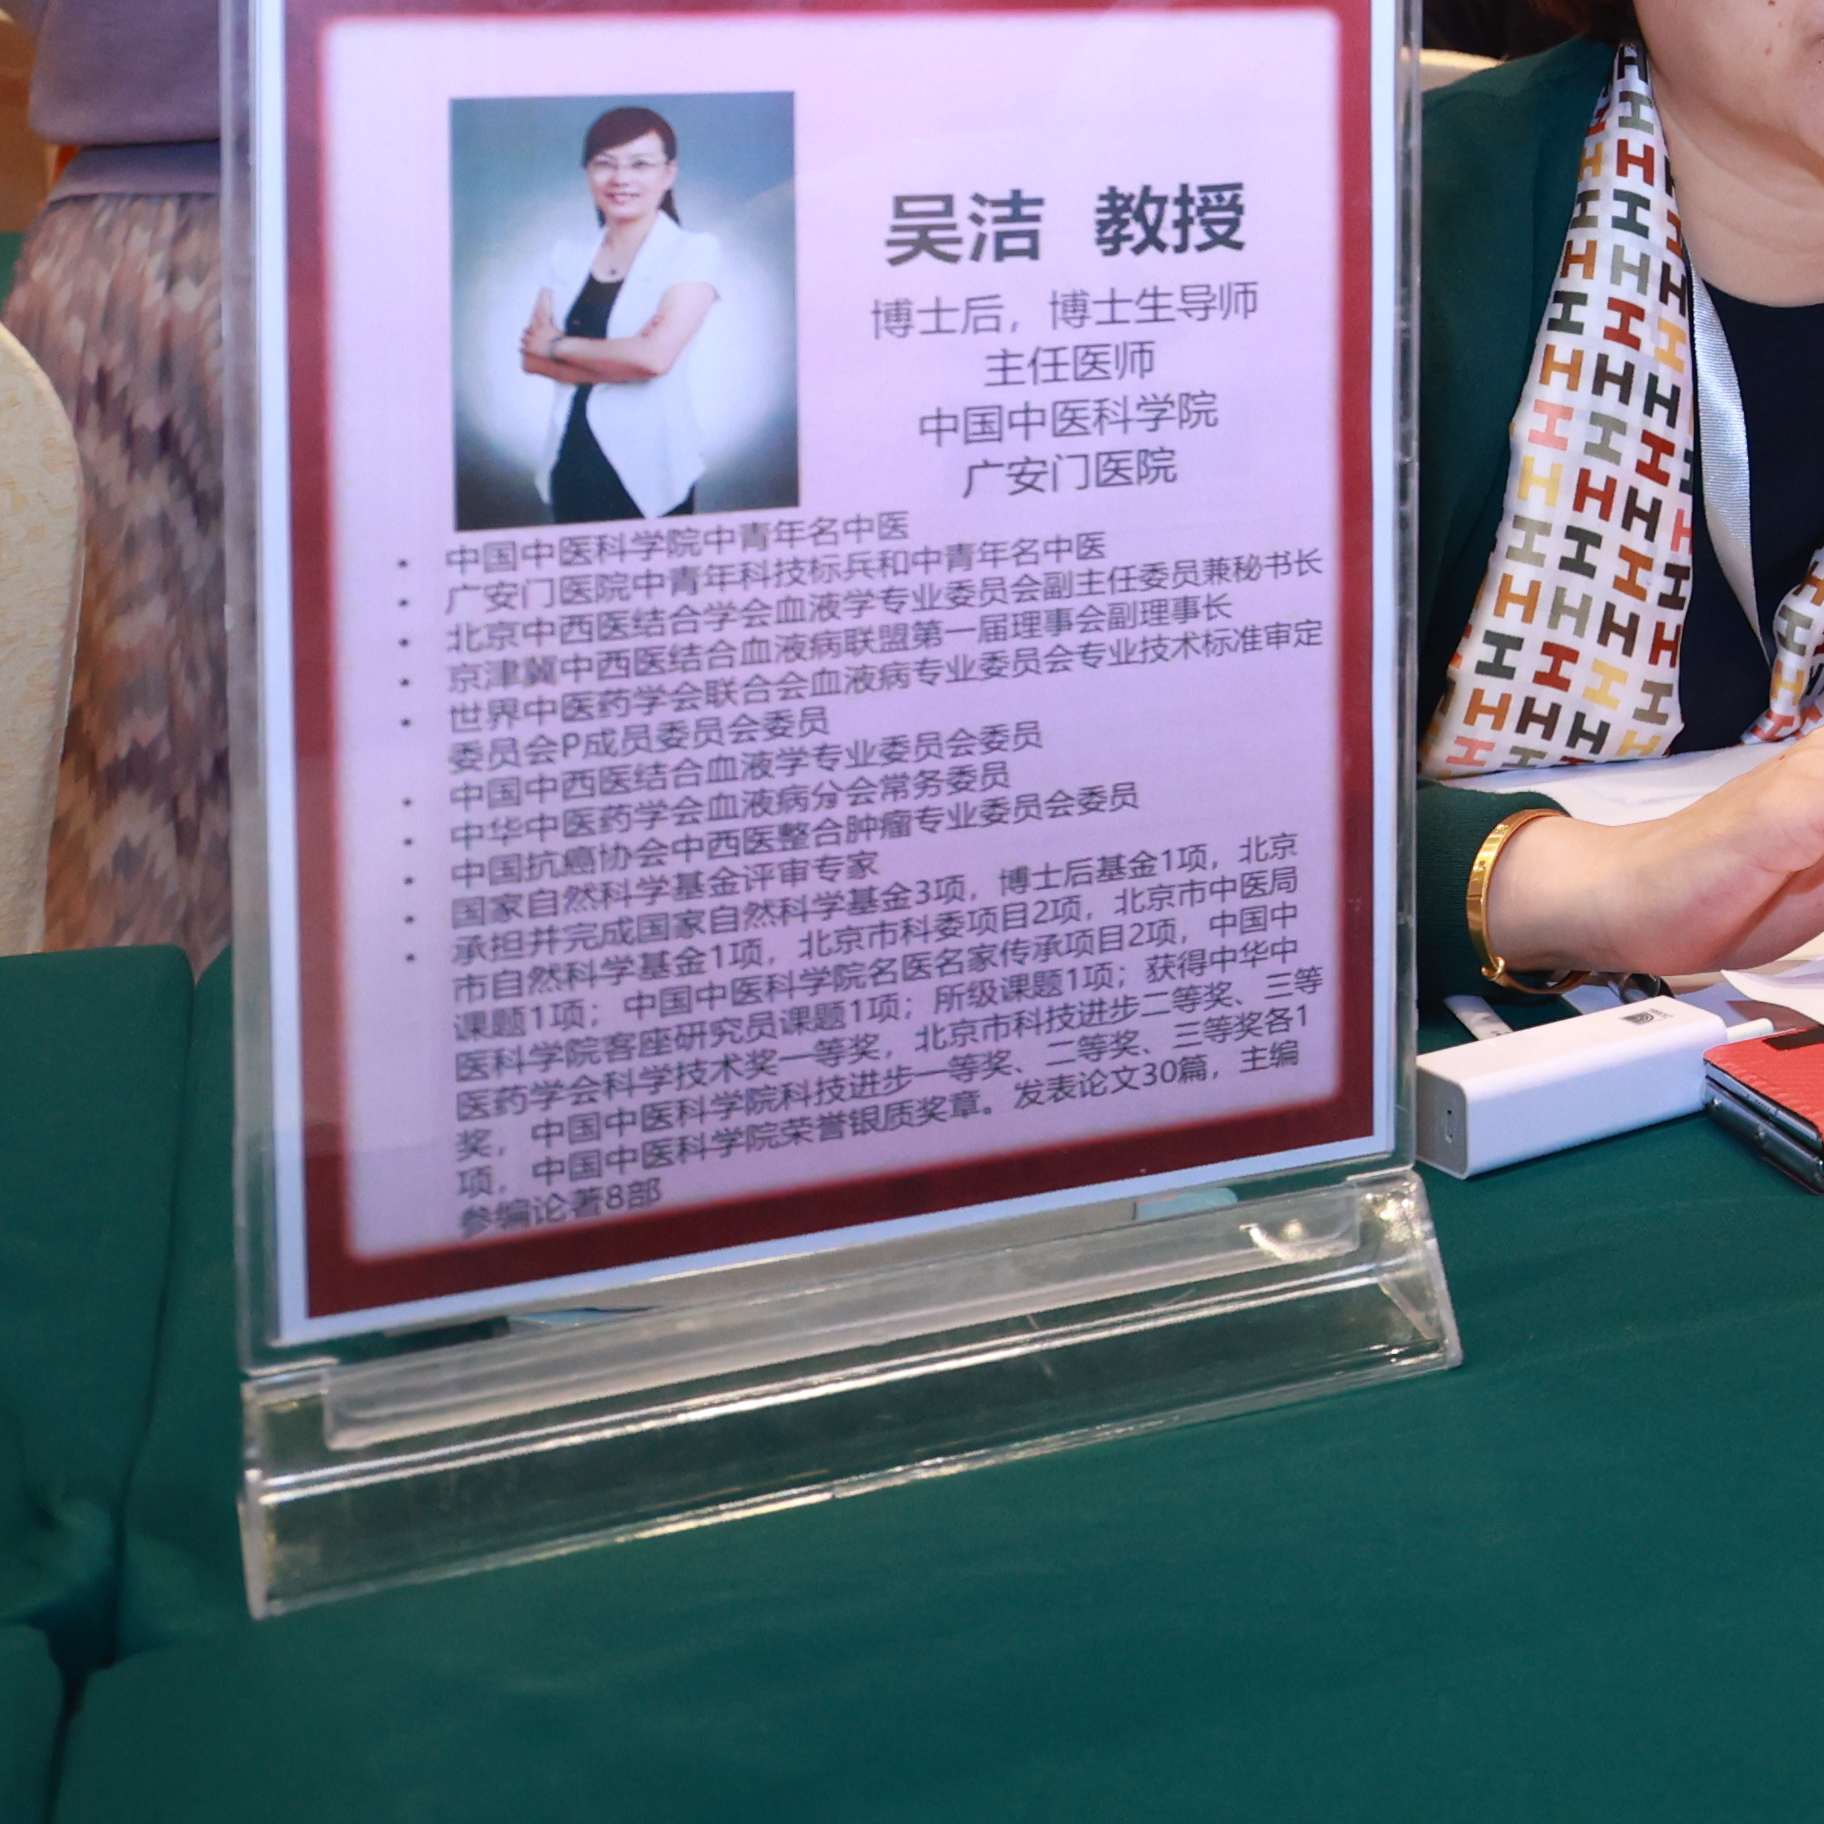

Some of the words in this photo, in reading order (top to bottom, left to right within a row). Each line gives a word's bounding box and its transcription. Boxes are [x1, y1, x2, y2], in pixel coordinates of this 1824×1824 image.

[886, 188, 1045, 267] 吴洁
[1094, 181, 1246, 257] 教授
[984, 340, 1156, 388] 主任医师
[918, 389, 1219, 449] 中国中医科学院
[962, 445, 1178, 499] 广安门医院
[445, 531, 1106, 615] 广安门医院中青年科技标兵和中青年名中医
[446, 510, 909, 576] 中国中医科学院中青年名中医
[447, 548, 1324, 655] 北京中西医结合学会血液学专业委员会副主任委员兼秘书长
[448, 593, 1233, 694] 京津冀中西医结合血液病联盟第一届理事会副理事长
[450, 620, 1324, 734] 世界中医药学会联合会血液病专业委员会专业技术标准审定
[449, 706, 830, 774] 委员会P成员委员会委员
[451, 720, 1043, 813] 中国中西医结合血液学专业委员会委员
[451, 760, 1010, 852] 中华中医药学会血液病分会常务委员
[452, 781, 1140, 890] 中国抗癌协会中西医整合肿瘤专业委员会委员
[452, 849, 879, 930] 国家自然科学基金评审专家
